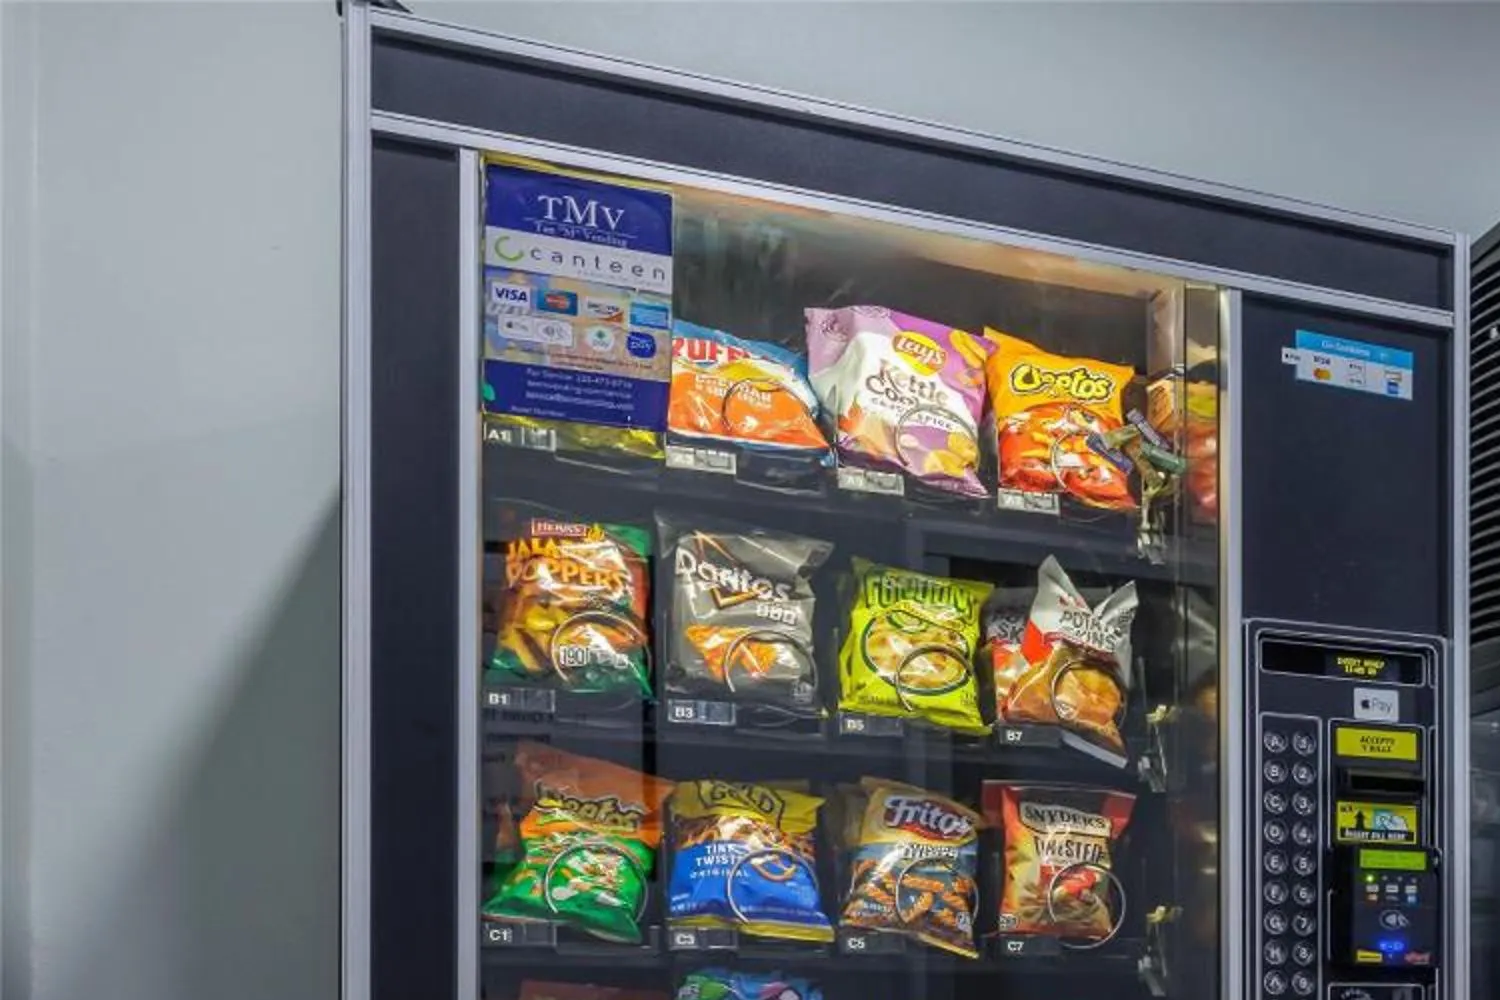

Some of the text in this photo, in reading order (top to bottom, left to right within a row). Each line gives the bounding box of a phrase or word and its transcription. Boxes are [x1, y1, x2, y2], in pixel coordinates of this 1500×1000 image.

[538, 195, 625, 231] TMV
[530, 247, 666, 281] canteen
[495, 287, 528, 302] VISA
[896, 337, 945, 366] Lay's
[675, 547, 791, 602] Doritos
[489, 692, 507, 705] B1
[1372, 696, 1393, 713] Pay
[675, 708, 694, 720] B3
[1006, 729, 1023, 742] B7
[884, 796, 973, 835] Fritos
[489, 930, 508, 941] C1
[675, 933, 695, 945] C3
[1007, 941, 1024, 951] C7
